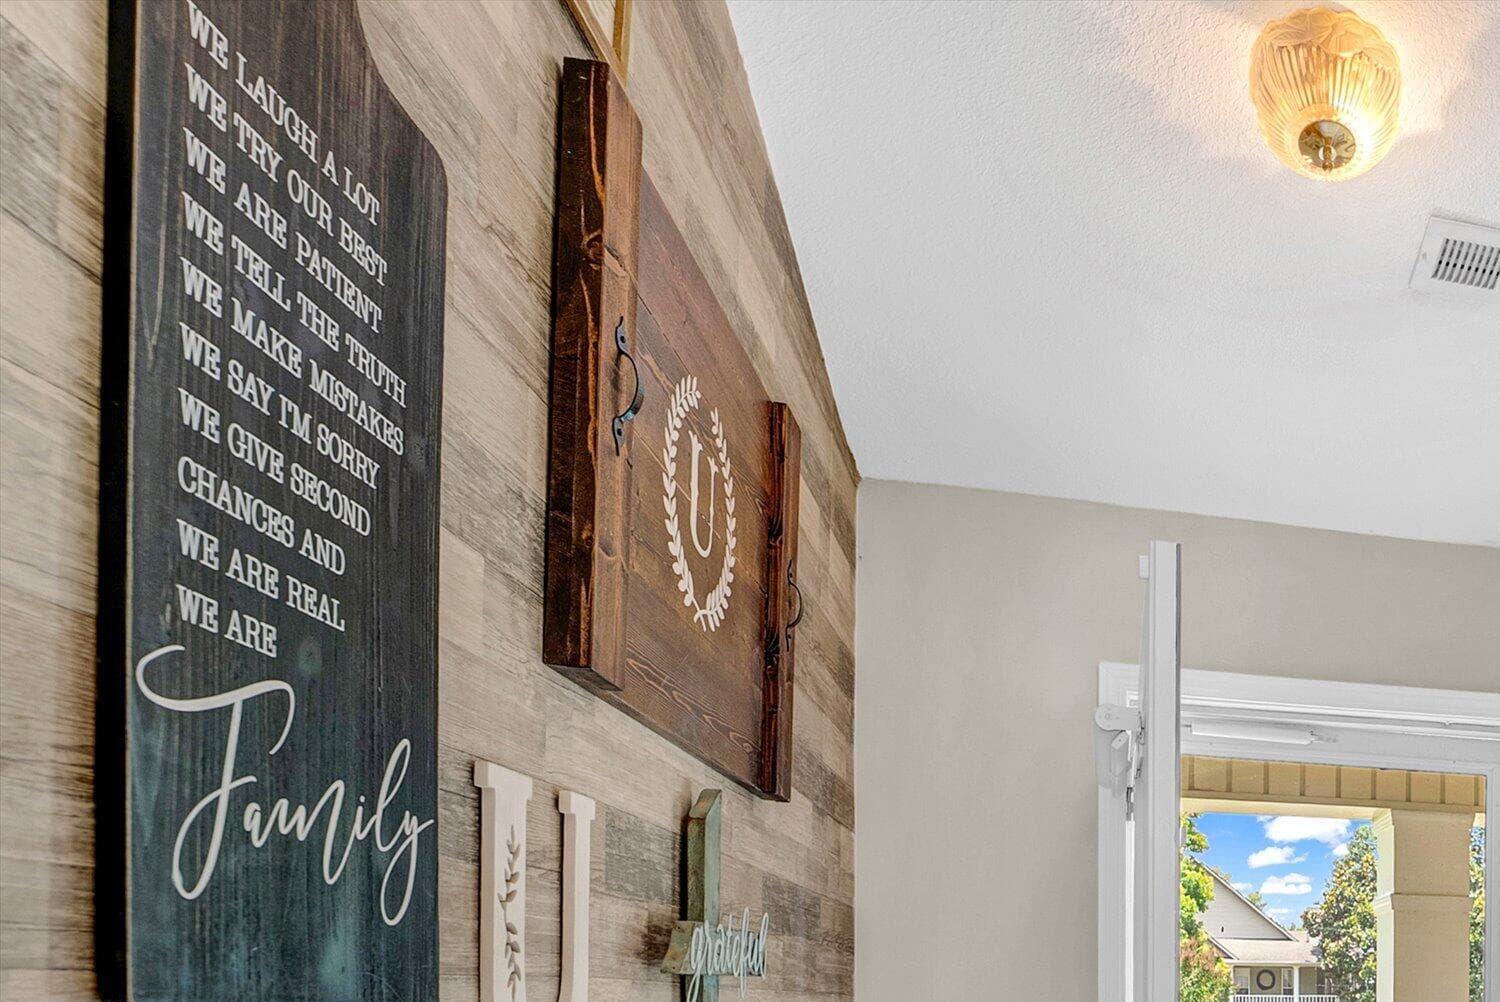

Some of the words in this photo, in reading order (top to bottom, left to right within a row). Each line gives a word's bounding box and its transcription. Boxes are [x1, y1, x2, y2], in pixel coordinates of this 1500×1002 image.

[184, 63, 227, 132] WE
[234, 116, 284, 183] TRY
[287, 169, 333, 237] OUR
[339, 217, 388, 286] BEST
[187, 0, 228, 70] WE
[236, 54, 317, 163] LAUGH
[323, 151, 338, 185] A
[344, 167, 380, 225] LOT
[182, 191, 224, 255] WE
[231, 235, 291, 312] TELL
[297, 292, 339, 352] THE
[346, 333, 406, 408] TRUTH
[183, 127, 226, 194] WE
[234, 183, 286, 250] ARE
[295, 231, 382, 333] PATIENT
[179, 323, 220, 381] WE
[228, 360, 276, 415] SAY
[279, 394, 311, 444] I'M
[317, 424, 380, 489] SORRY
[180, 257, 222, 317] WE
[231, 298, 302, 379] MAKE
[309, 360, 404, 456] MISTAKES
[178, 388, 220, 445] WE
[228, 423, 284, 484] GIVE
[290, 463, 371, 536] SECOND
[178, 456, 294, 549] CHANCES
[300, 531, 345, 576] AND
[686, 430, 718, 558] U
[176, 584, 218, 634] WE
[225, 608, 277, 658] ARE
[177, 519, 219, 571] WE
[226, 548, 279, 600] ARE
[286, 575, 345, 632] REAL
[136, 644, 434, 926] Family
